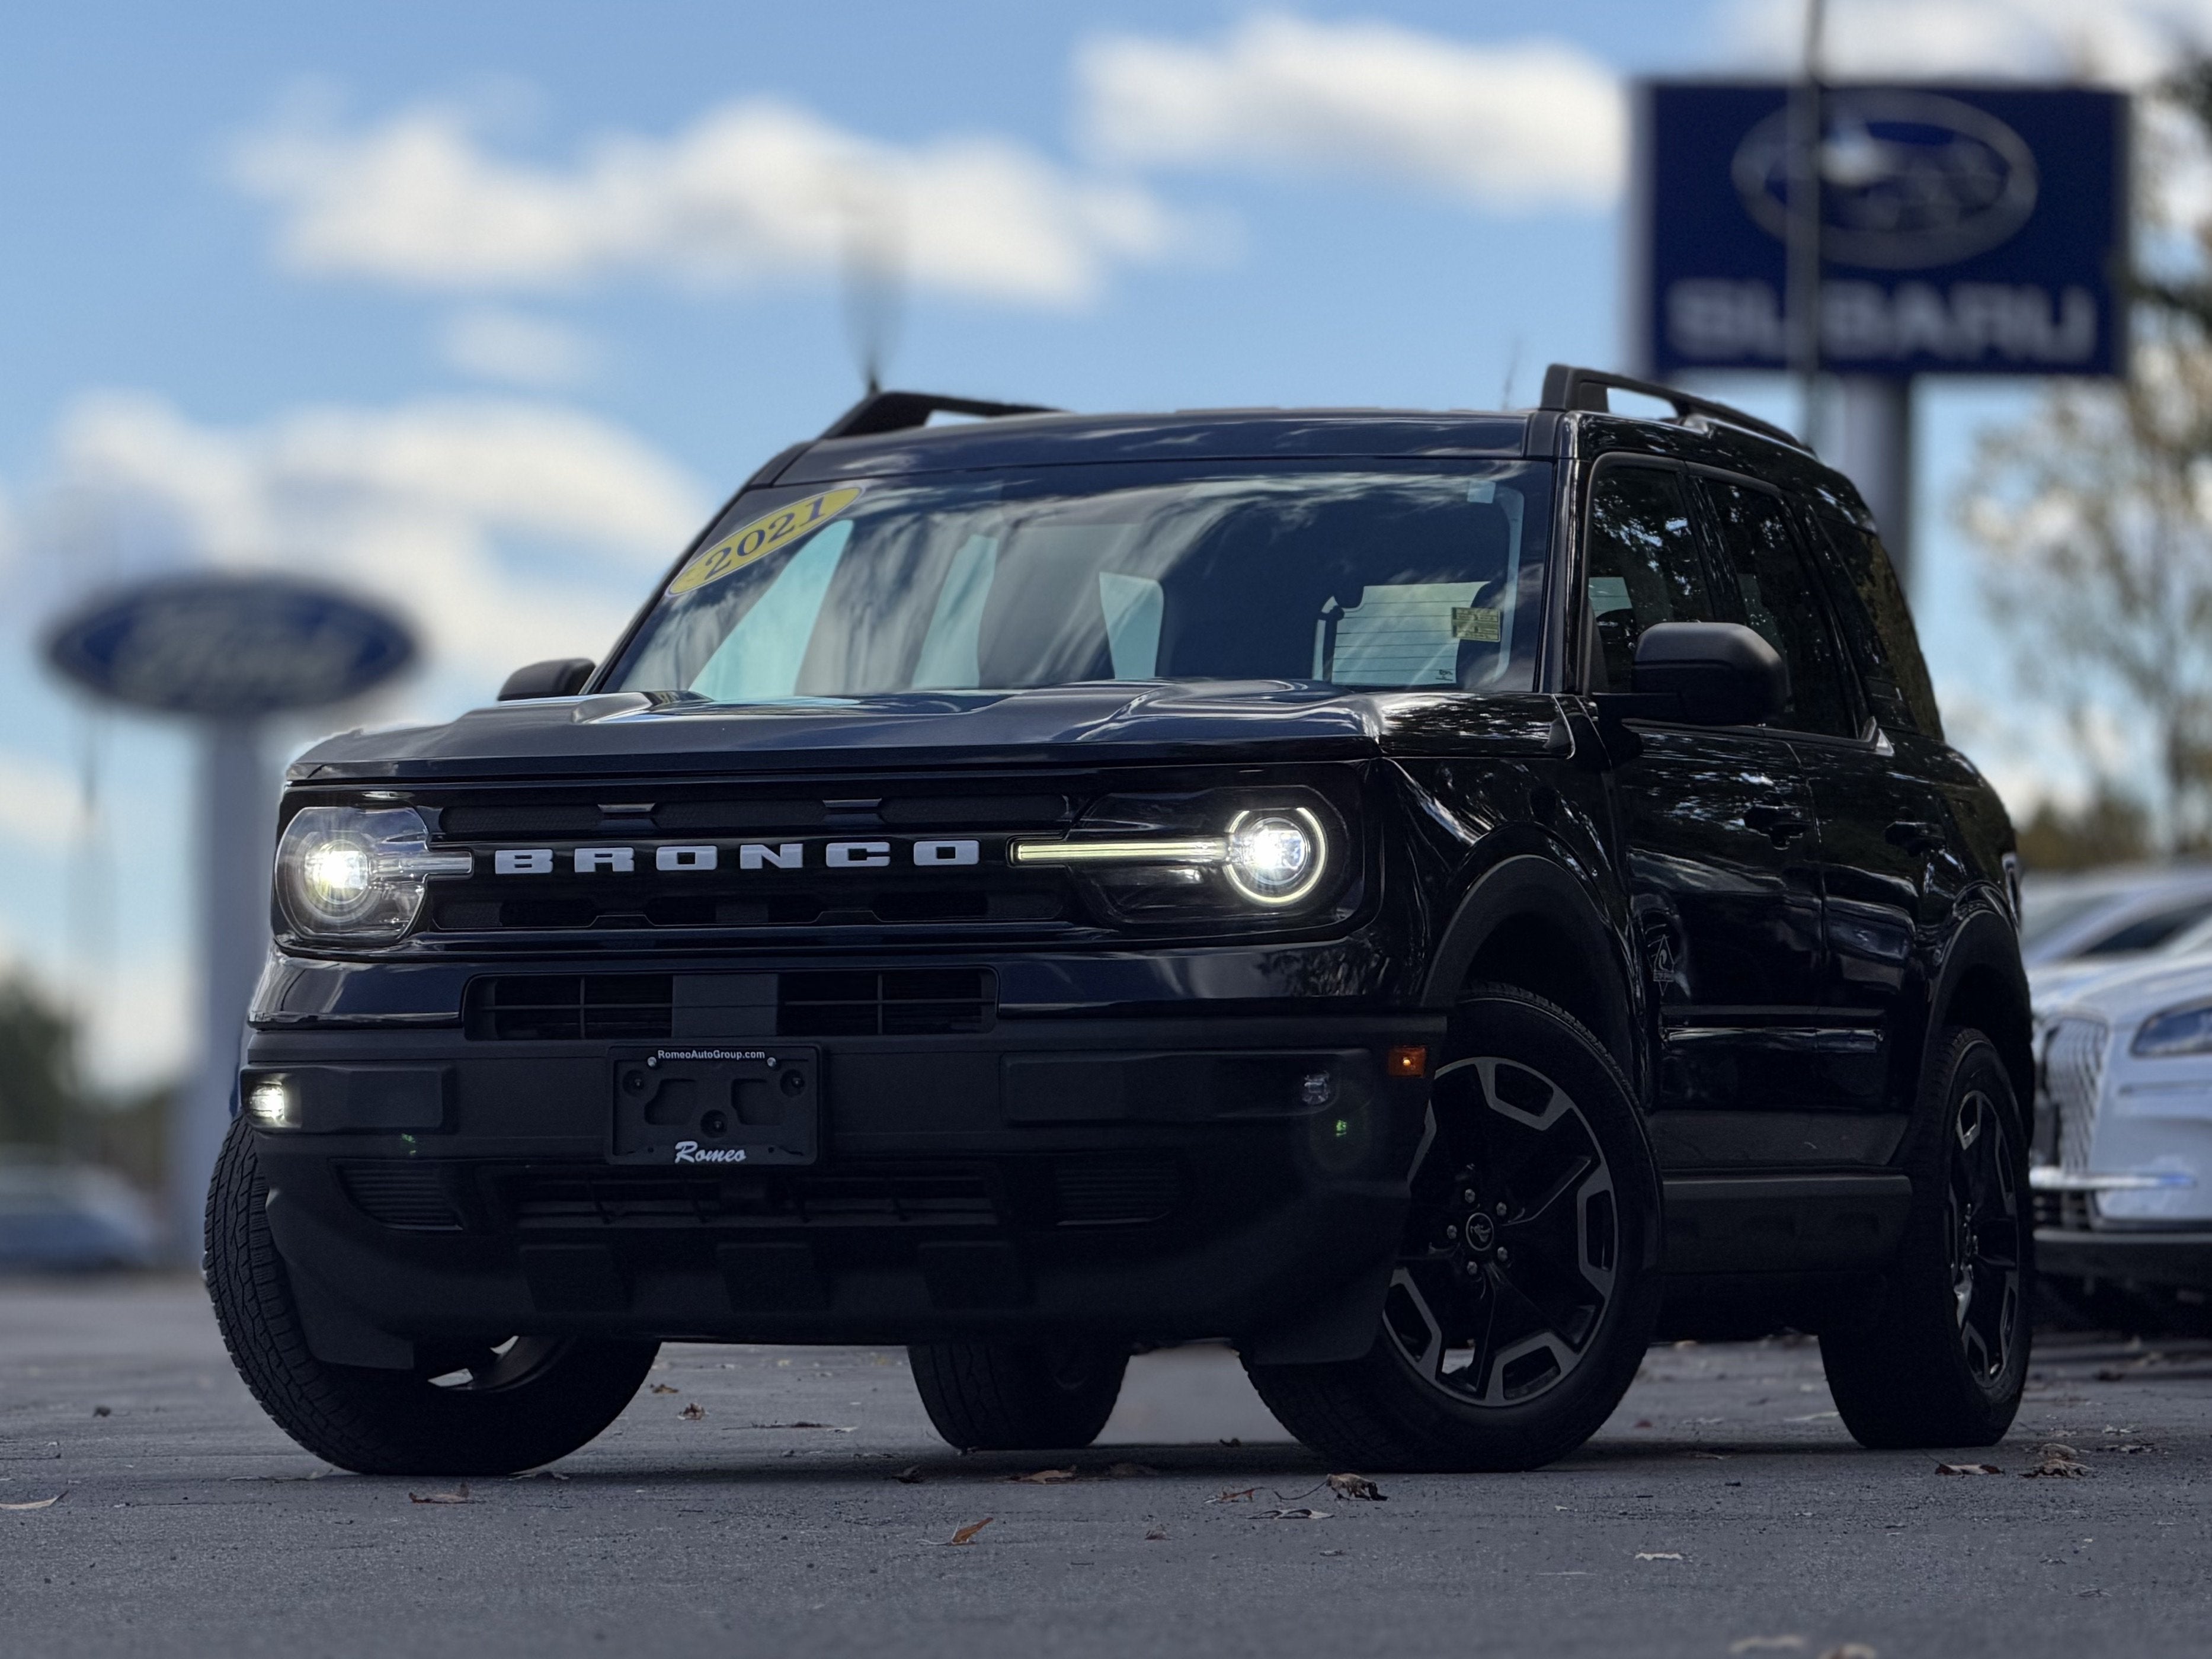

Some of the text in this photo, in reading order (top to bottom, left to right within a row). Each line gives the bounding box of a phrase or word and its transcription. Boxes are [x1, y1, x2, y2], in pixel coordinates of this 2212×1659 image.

[704, 497, 826, 580] 2021
[494, 840, 979, 874] BRONCO
[657, 1049, 766, 1061] RomeoAutoGroup.com
[674, 1141, 747, 1164] Romeo
